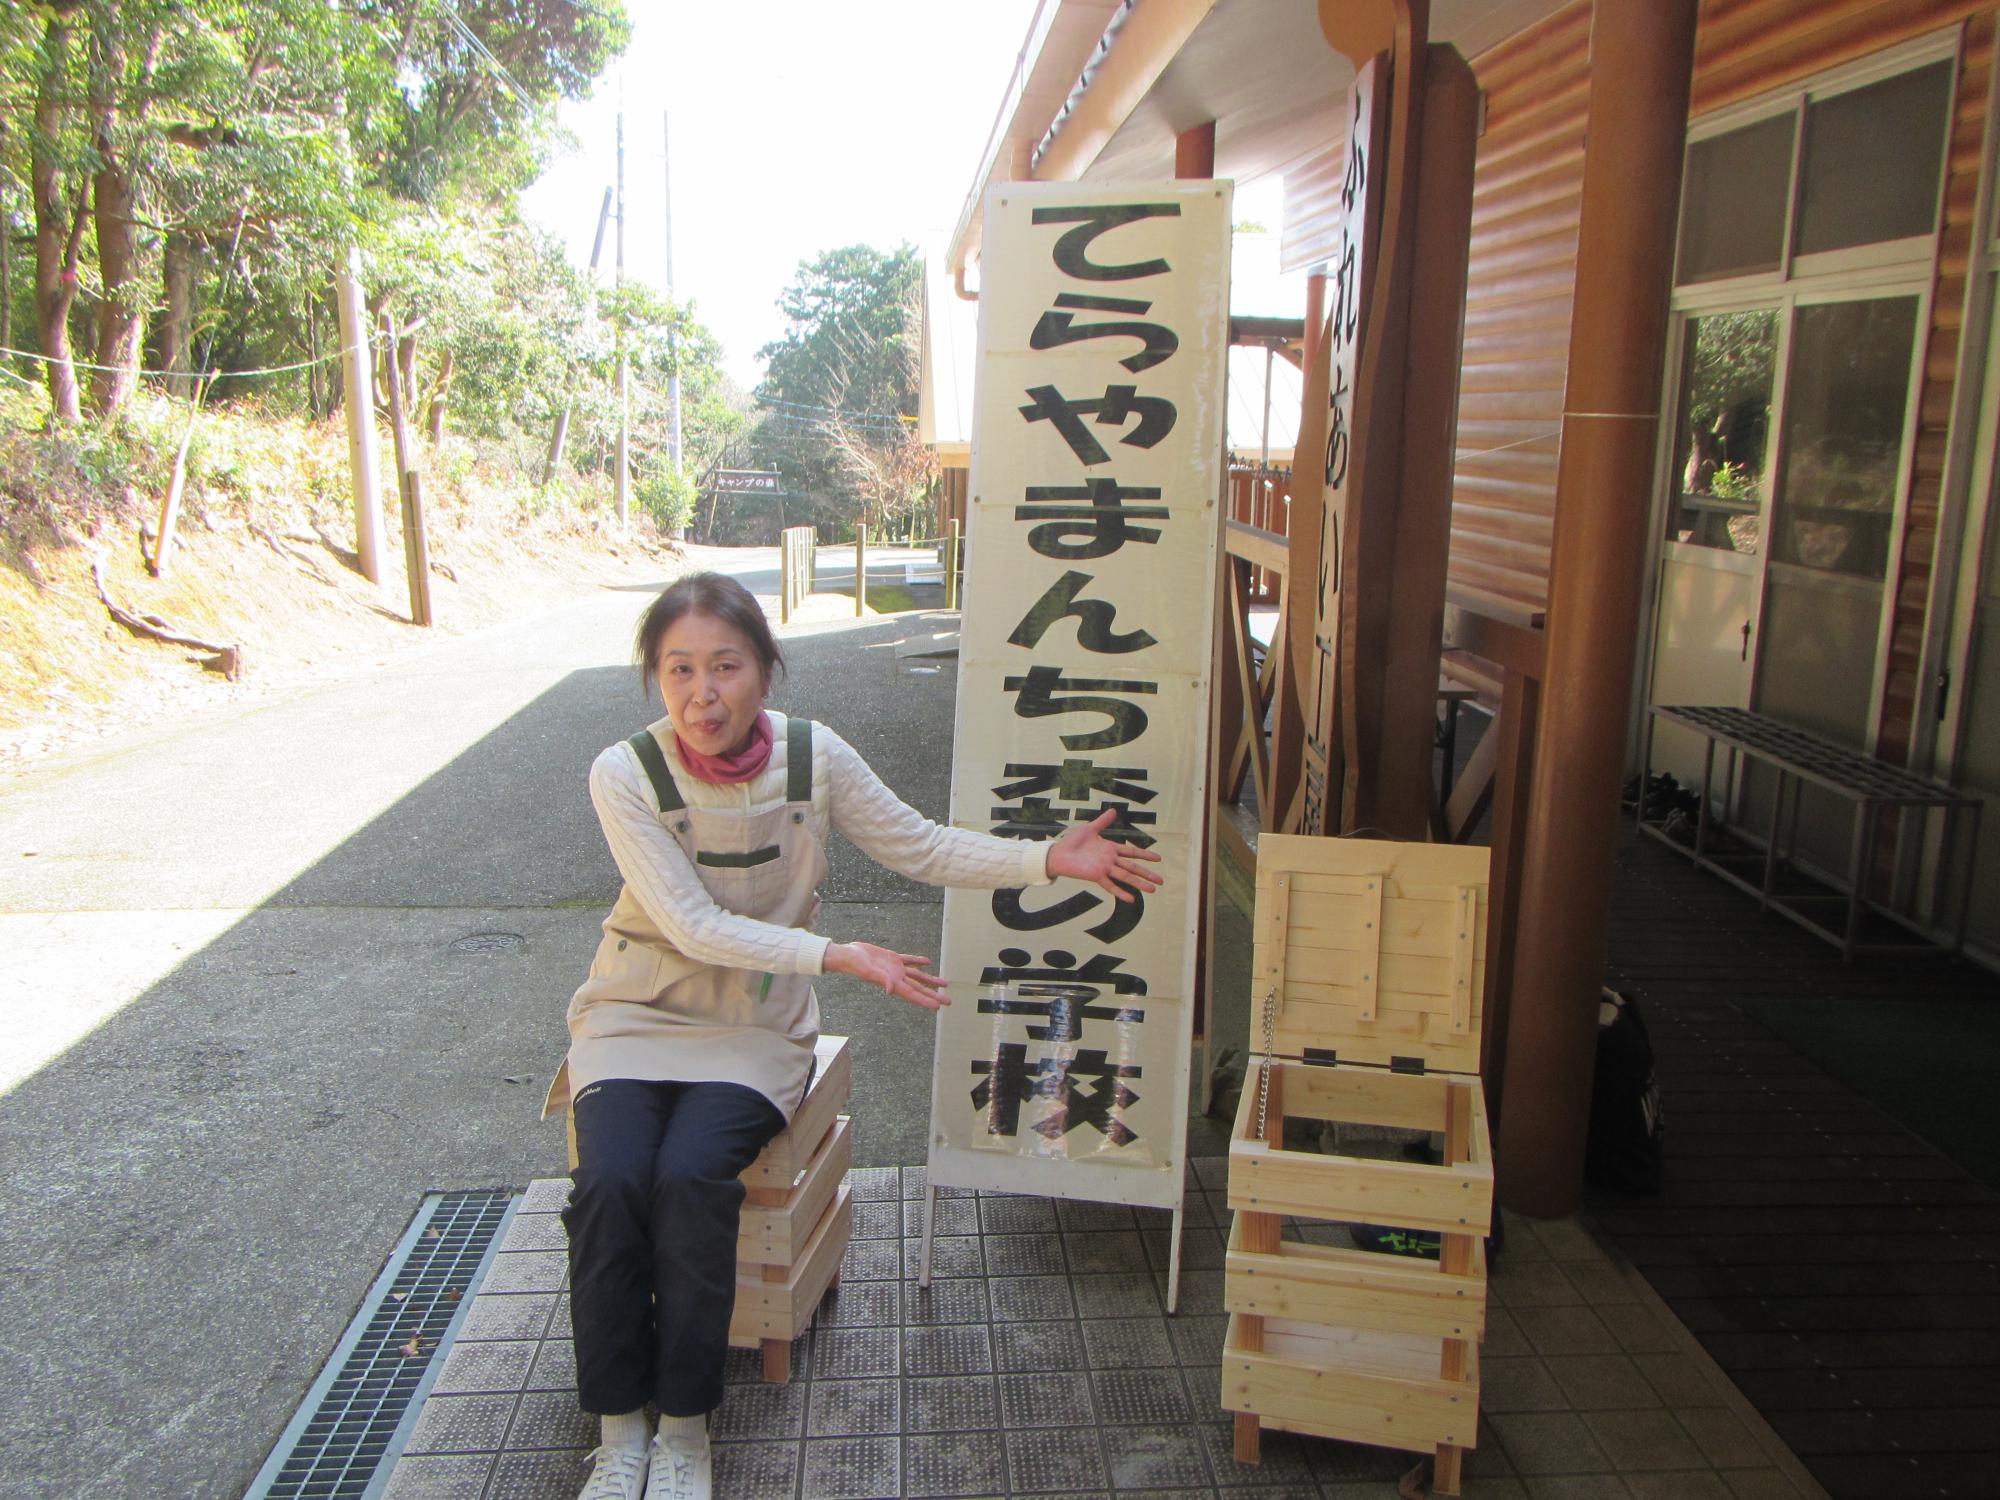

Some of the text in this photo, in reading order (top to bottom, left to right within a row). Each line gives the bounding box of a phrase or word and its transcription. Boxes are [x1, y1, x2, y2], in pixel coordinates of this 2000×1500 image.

[970, 203, 1181, 1147] てらやまんち森の学校
